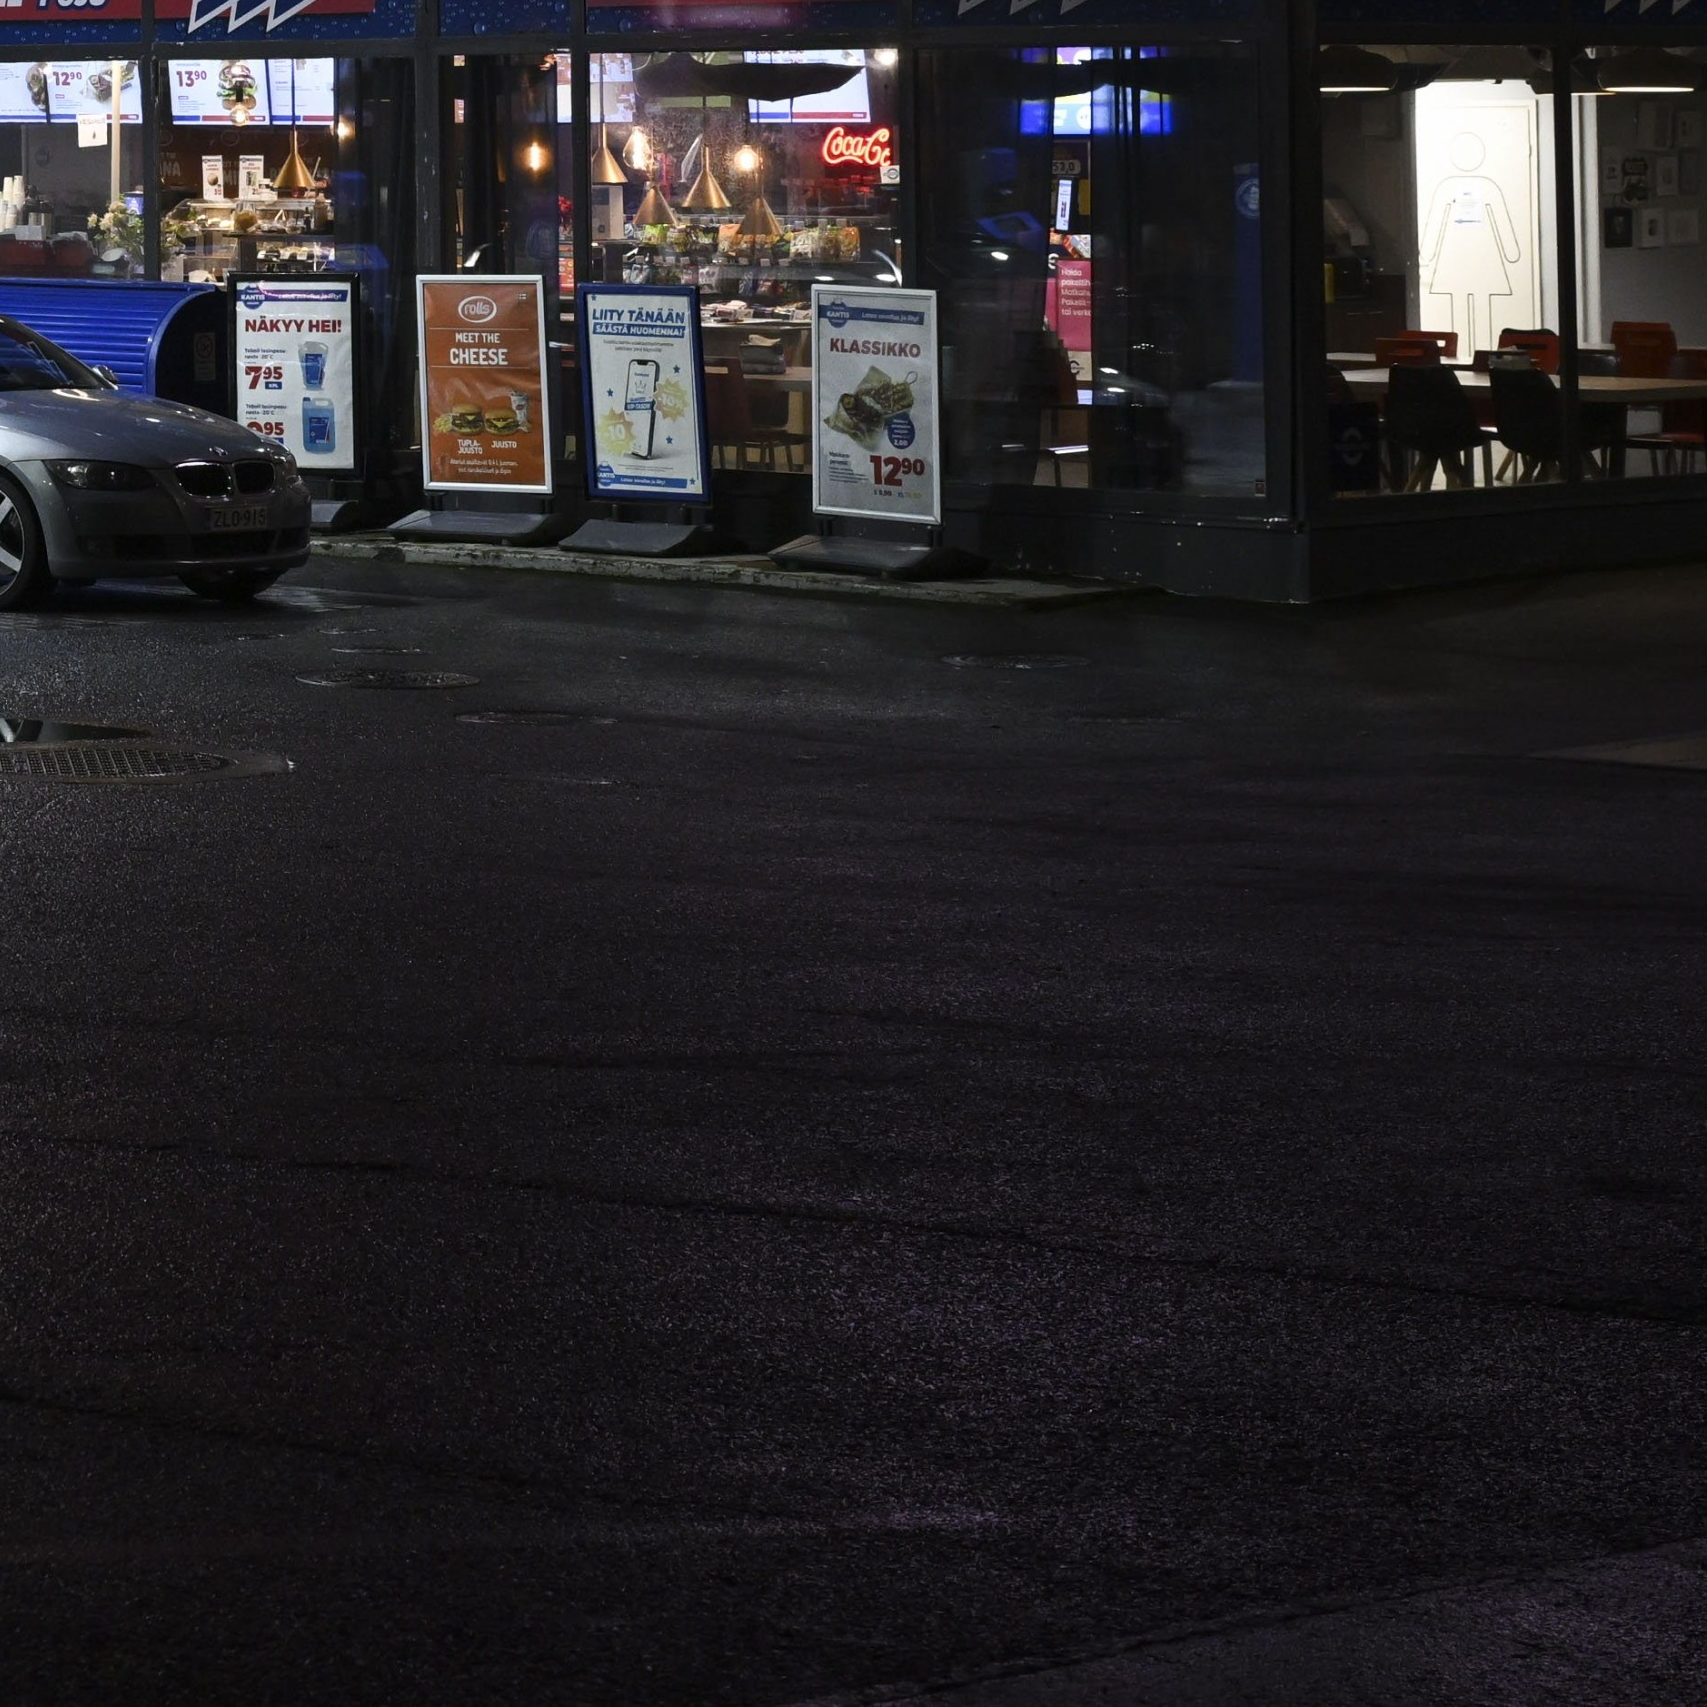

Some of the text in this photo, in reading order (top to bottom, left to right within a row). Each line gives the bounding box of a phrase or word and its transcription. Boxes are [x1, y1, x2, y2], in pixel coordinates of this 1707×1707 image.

[464, 301, 491, 316] rolls
[592, 307, 685, 324] LIITY TÄNÄÄN
[245, 315, 342, 333] NÄKYY HEI!
[595, 323, 684, 337] SÄÄSTÄ HUOMENNA!
[455, 332, 501, 343] MEET THE
[830, 338, 921, 358] KLASSIKKO
[449, 348, 508, 365] CHEESE
[458, 446, 483, 454] JUUSTO
[491, 440, 517, 448] JUUSTO
